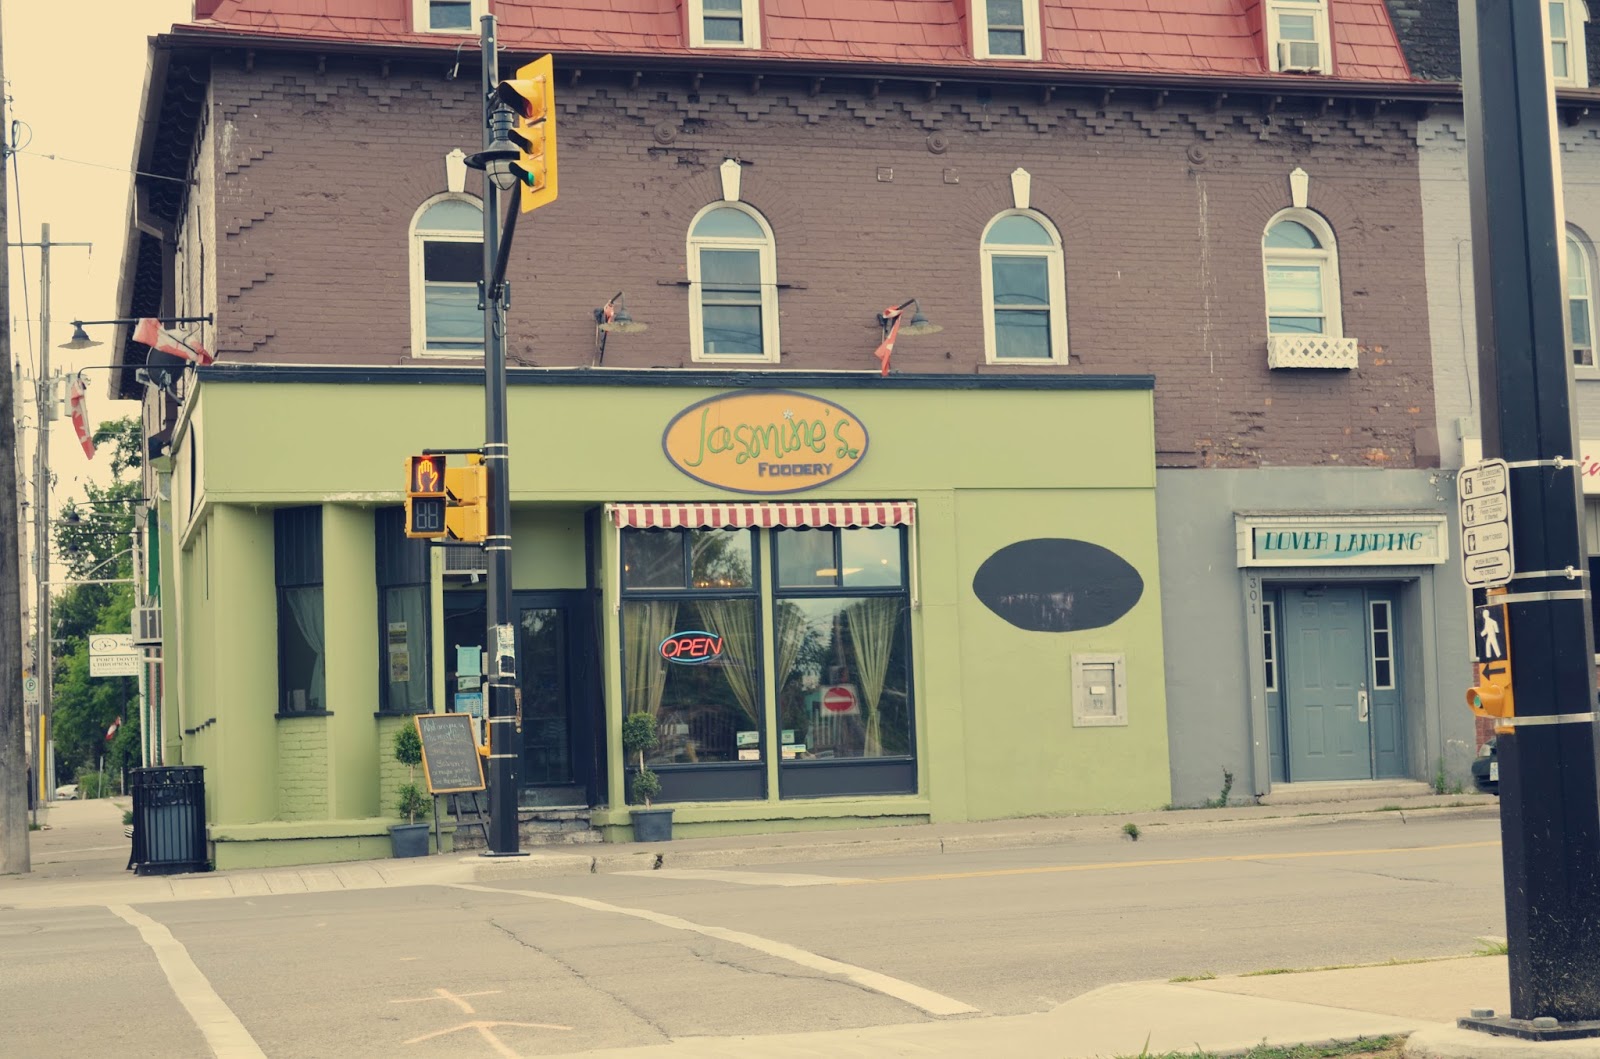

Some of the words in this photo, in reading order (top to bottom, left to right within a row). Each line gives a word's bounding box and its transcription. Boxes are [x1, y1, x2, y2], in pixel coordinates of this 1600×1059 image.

[683, 407, 857, 467] Jasmine's
[758, 462, 833, 477] FOODERY
[1264, 531, 1329, 550] DOVER
[1334, 532, 1423, 552] LANDING
[661, 637, 723, 657] OPEN
